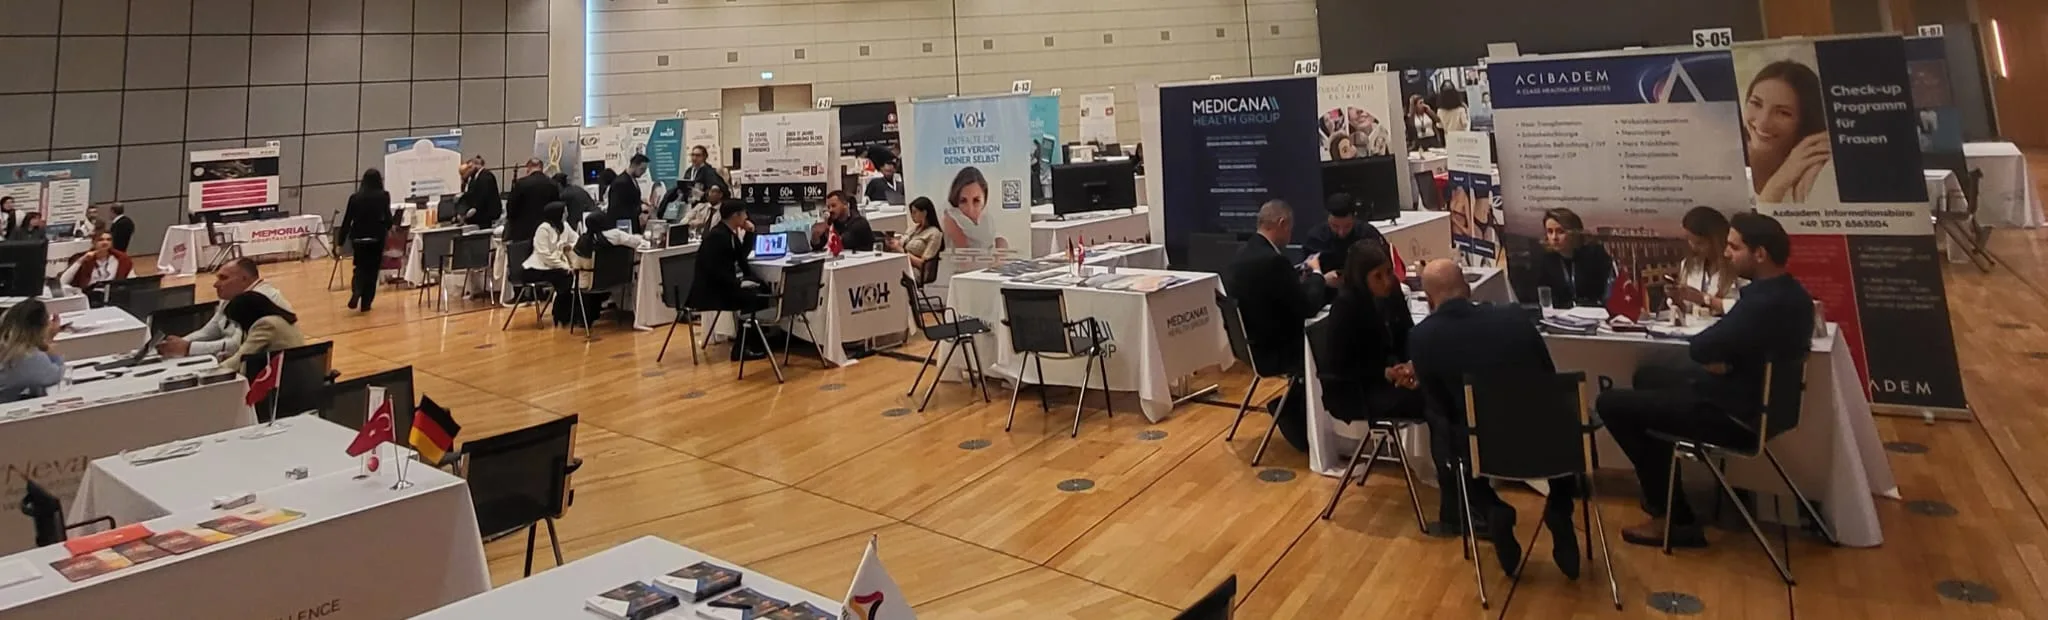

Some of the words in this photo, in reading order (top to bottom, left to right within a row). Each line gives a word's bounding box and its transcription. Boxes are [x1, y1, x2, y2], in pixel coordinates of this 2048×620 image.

[1695, 31, 1731, 47] S-05
[1295, 62, 1318, 75] A-05
[1515, 69, 1609, 86] ACIBADEM
[1013, 82, 1030, 93] A-13
[1830, 84, 1903, 97] Check-up
[1192, 96, 1271, 115] MEDICANA
[1833, 101, 1908, 115] Programm
[1193, 115, 1237, 127] HEALTH
[1240, 112, 1281, 125] GROUP
[1836, 118, 1857, 129] für
[1838, 134, 1889, 145] Frauen
[943, 146, 966, 155] BESTE
[967, 144, 1000, 154] VERSION
[944, 155, 971, 165] DEINER
[973, 154, 1000, 164] SELBST
[748, 186, 754, 196] 9
[764, 186, 770, 197] 4
[252, 225, 310, 239] MEMORIAL
